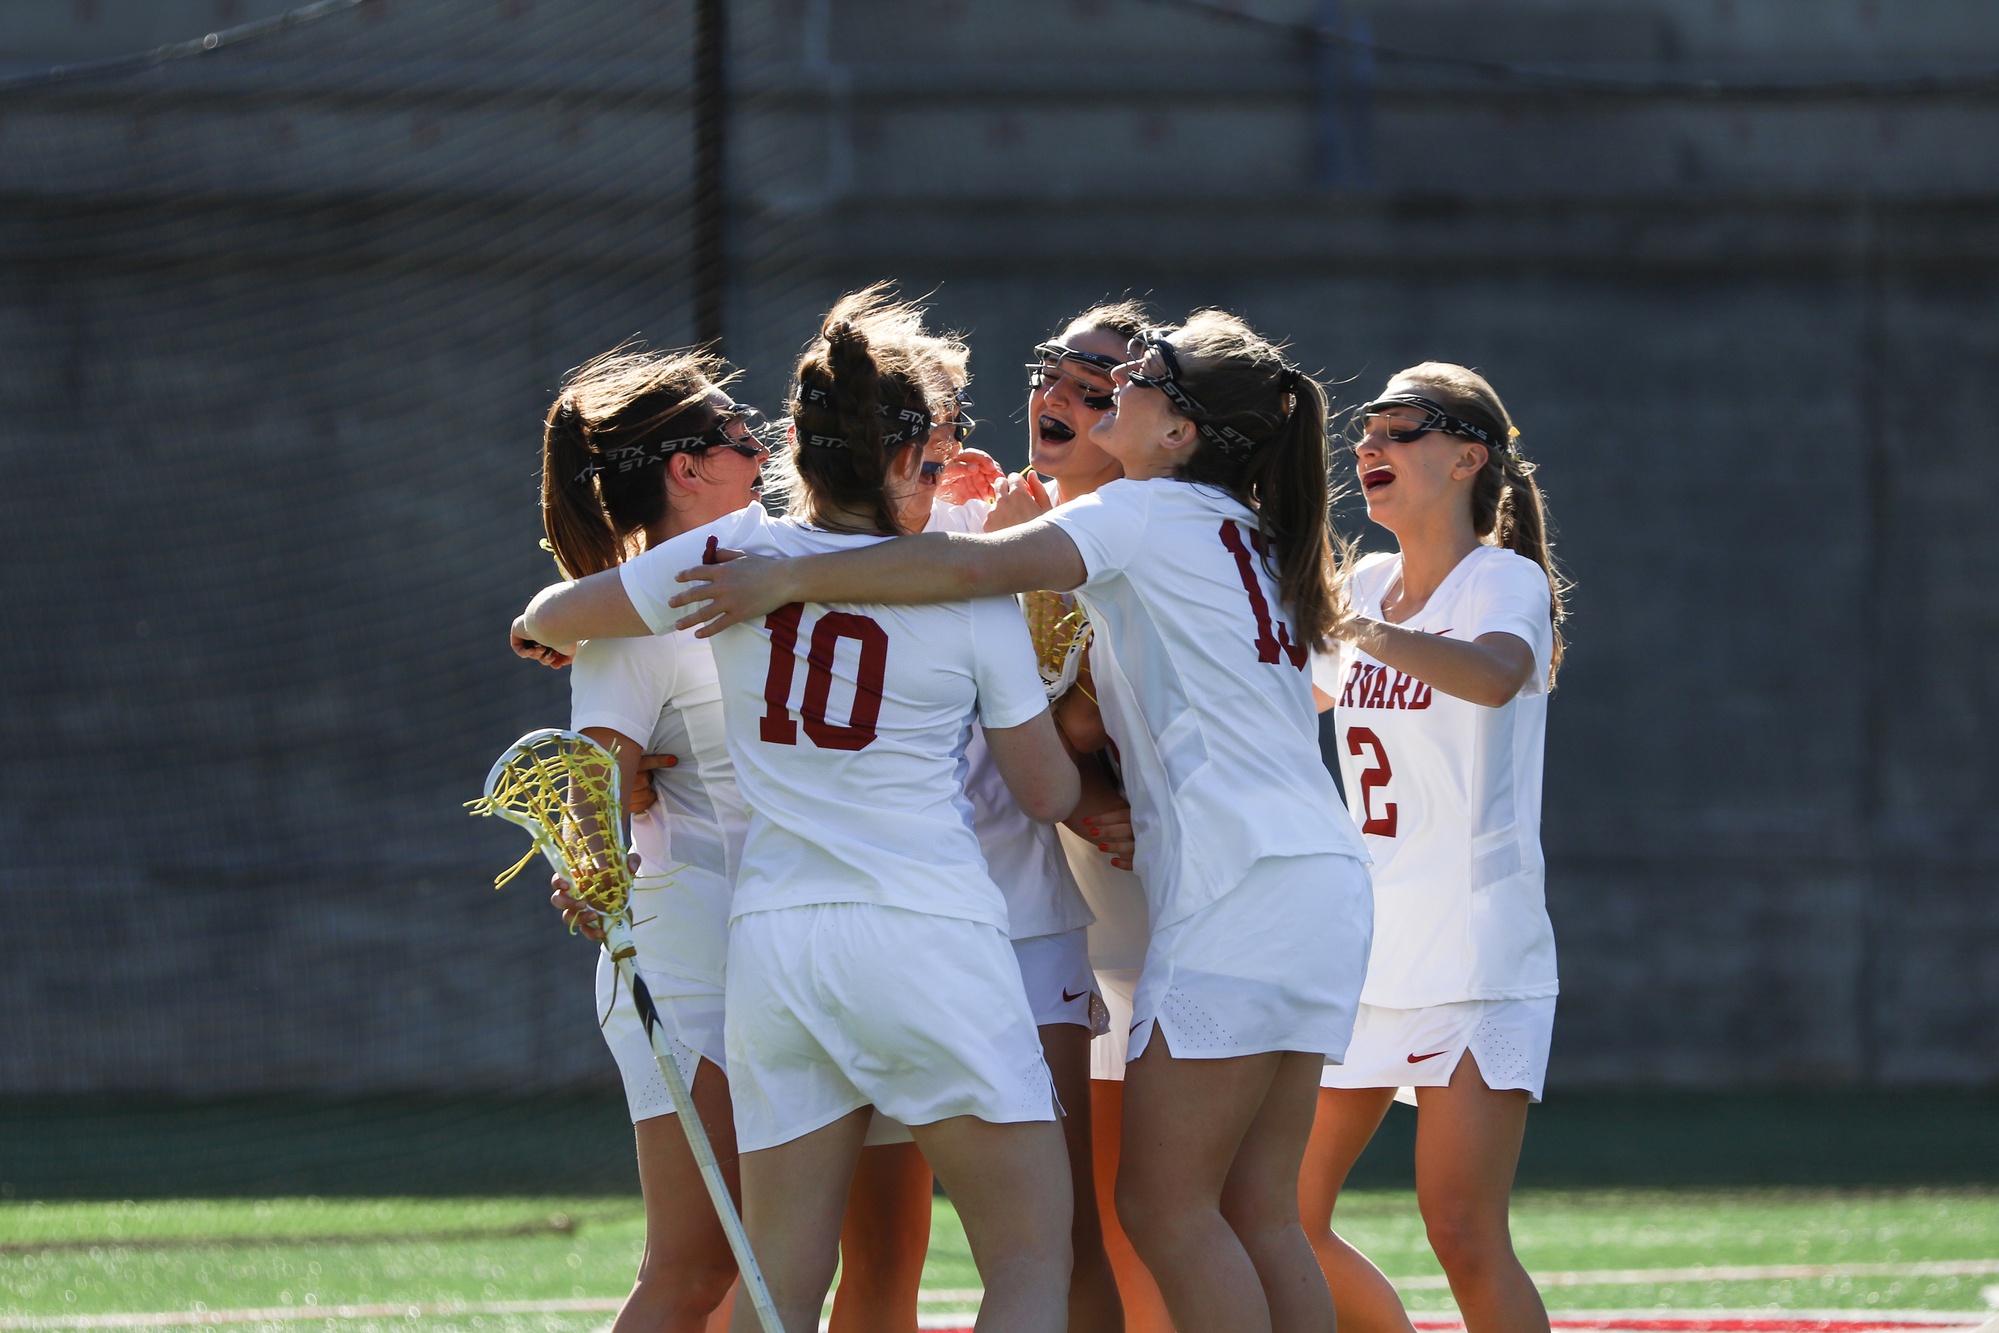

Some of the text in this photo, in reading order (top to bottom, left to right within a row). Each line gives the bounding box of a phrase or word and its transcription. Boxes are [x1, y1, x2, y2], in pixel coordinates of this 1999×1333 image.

[1162, 381, 1195, 411] STX
[899, 409, 925, 425] STX
[661, 436, 706, 452] STX
[810, 435, 850, 448] STX
[881, 431, 903, 446] TX
[1200, 424, 1234, 455] STX
[1220, 426, 1256, 450] STX
[606, 445, 645, 461] STX
[760, 602, 888, 751] 10
[1347, 727, 1397, 838] 2
